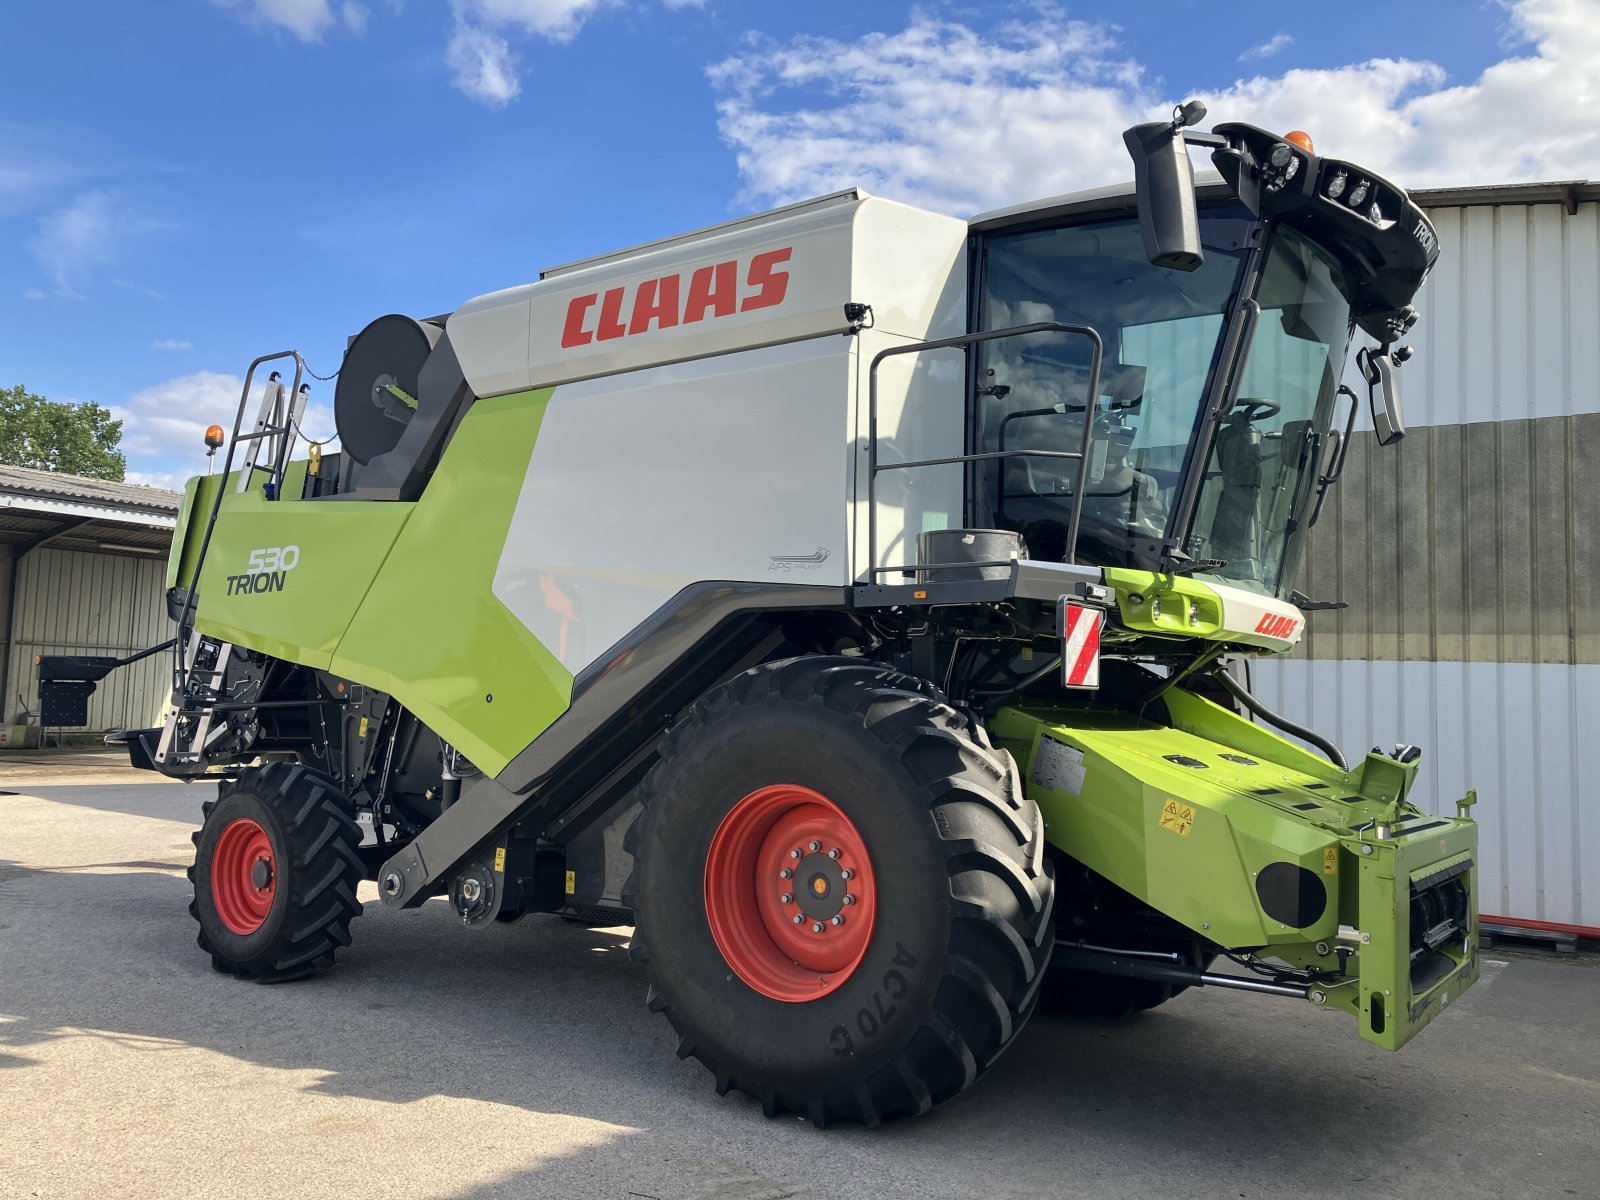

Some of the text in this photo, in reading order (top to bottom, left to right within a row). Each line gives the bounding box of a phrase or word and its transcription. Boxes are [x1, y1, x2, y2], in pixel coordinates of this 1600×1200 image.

[1412, 218, 1436, 254] TRION
[561, 246, 793, 349] CLAAS
[247, 545, 300, 575] 530
[768, 561, 792, 573] APS
[226, 570, 287, 597] TRION
[1254, 612, 1299, 639] CLAAS
